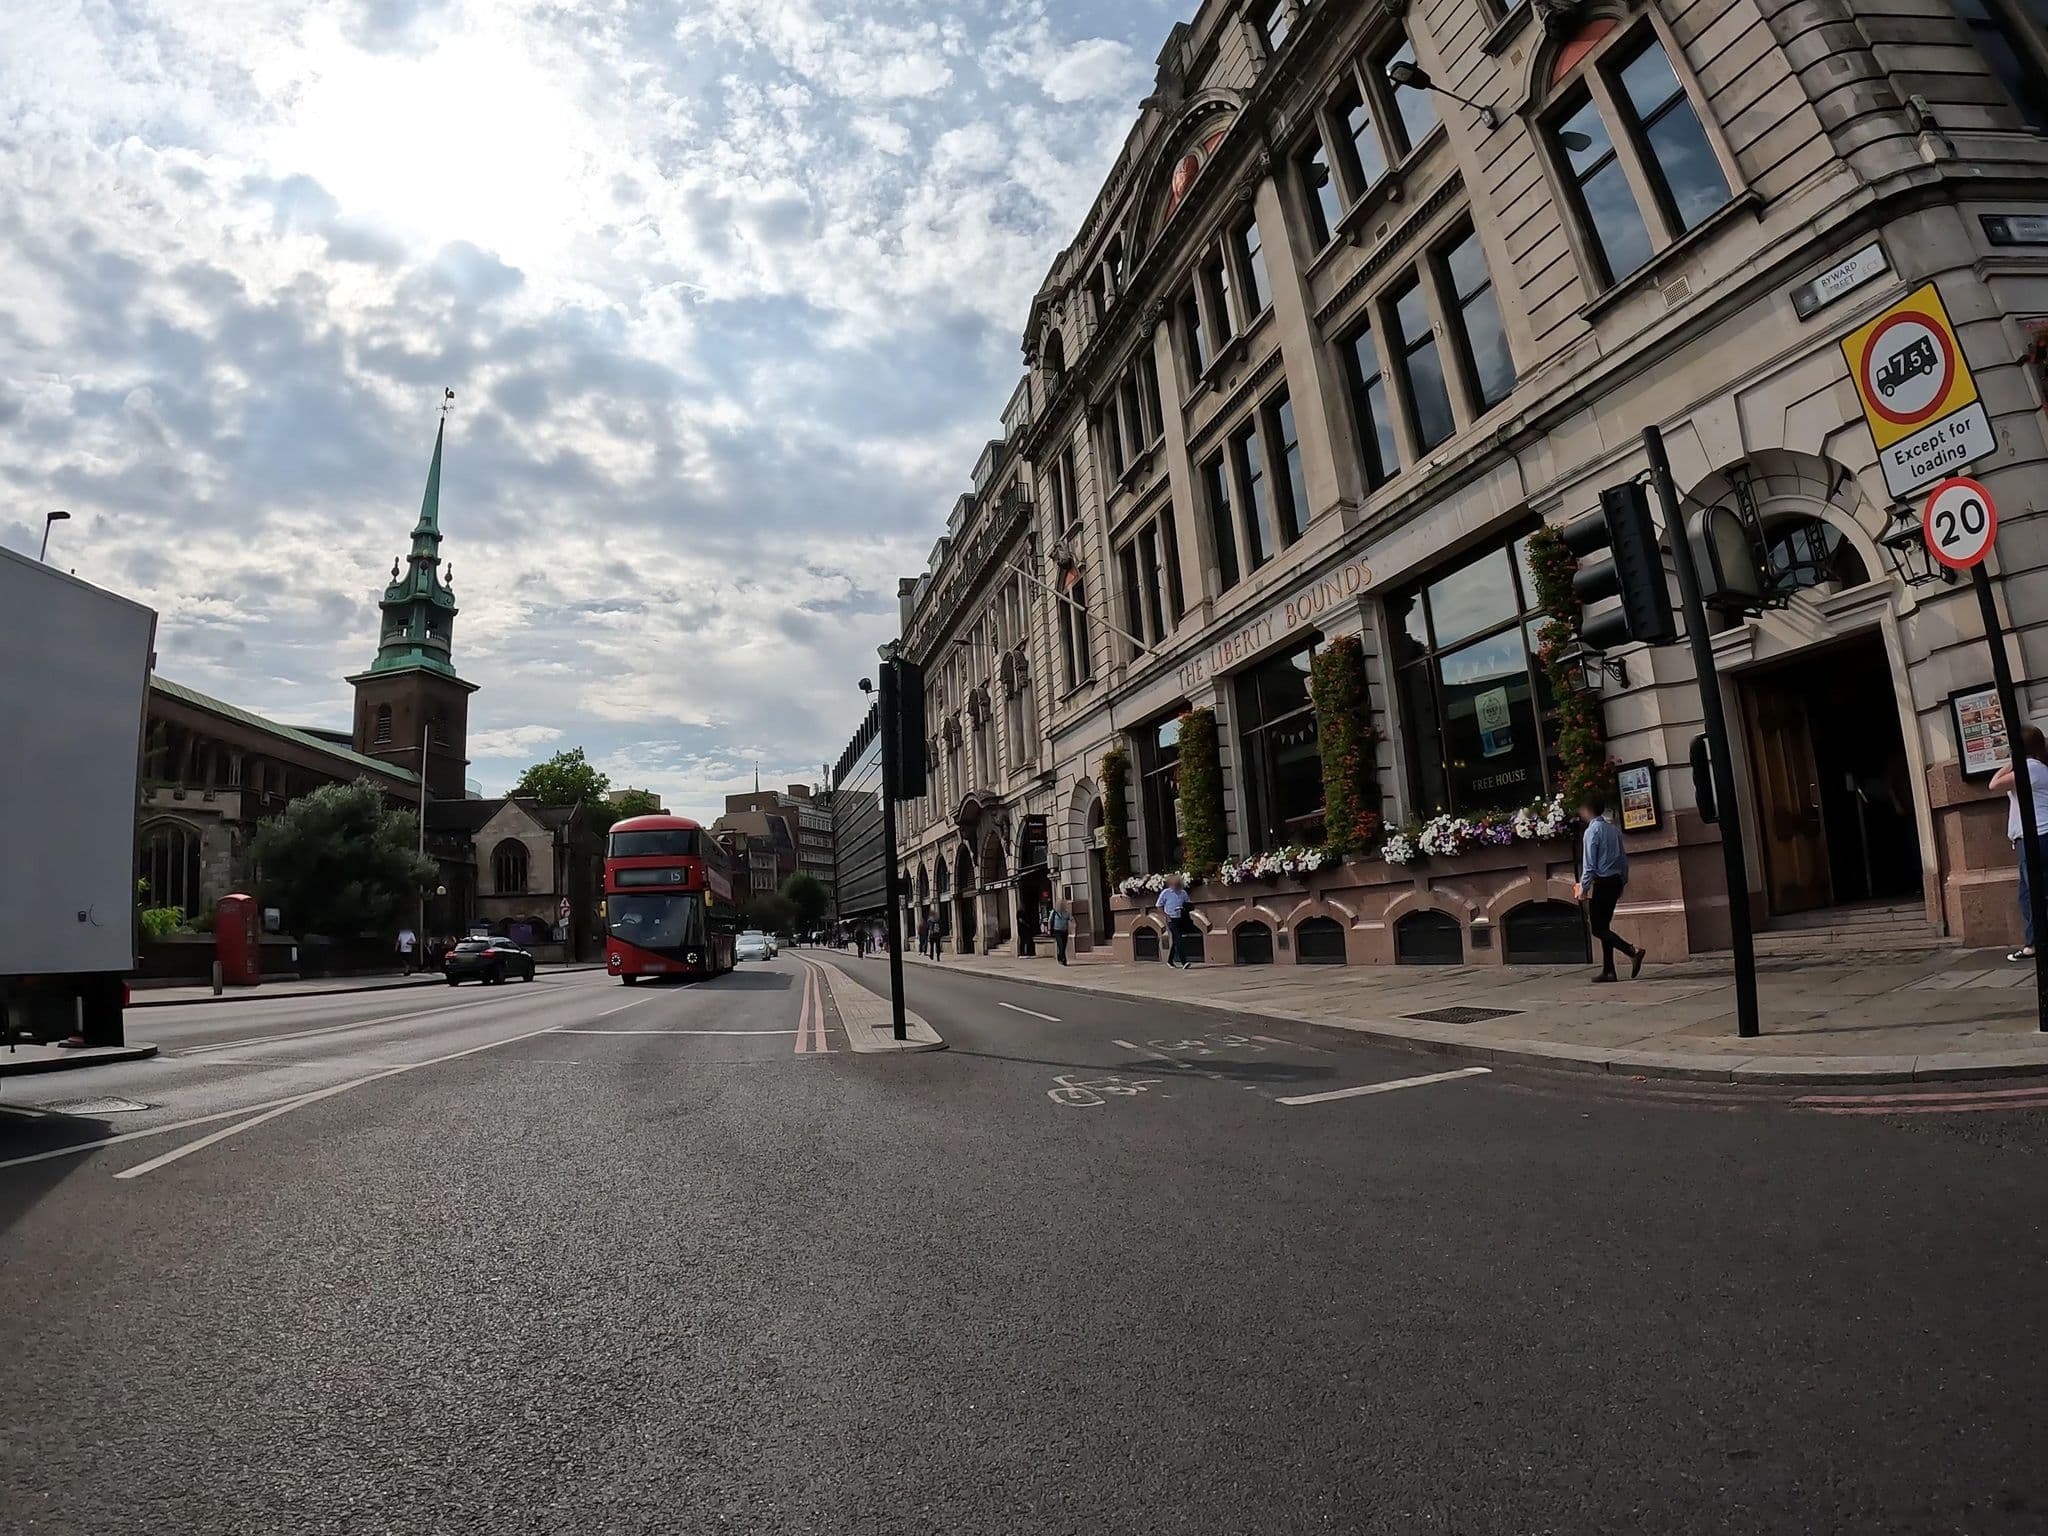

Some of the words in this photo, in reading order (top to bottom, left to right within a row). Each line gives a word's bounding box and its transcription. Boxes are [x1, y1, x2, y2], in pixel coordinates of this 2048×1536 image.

[1894, 429, 1946, 466] Except
[1949, 418, 1972, 438] for
[1910, 443, 1967, 478] loading
[1935, 498, 1985, 548] 20
[1176, 656, 1204, 691] THE
[1210, 613, 1273, 673] LIBERTY
[1285, 556, 1373, 629] BOUNDS
[1472, 776, 1495, 791] FREE
[1495, 768, 1527, 786] HOUSE
